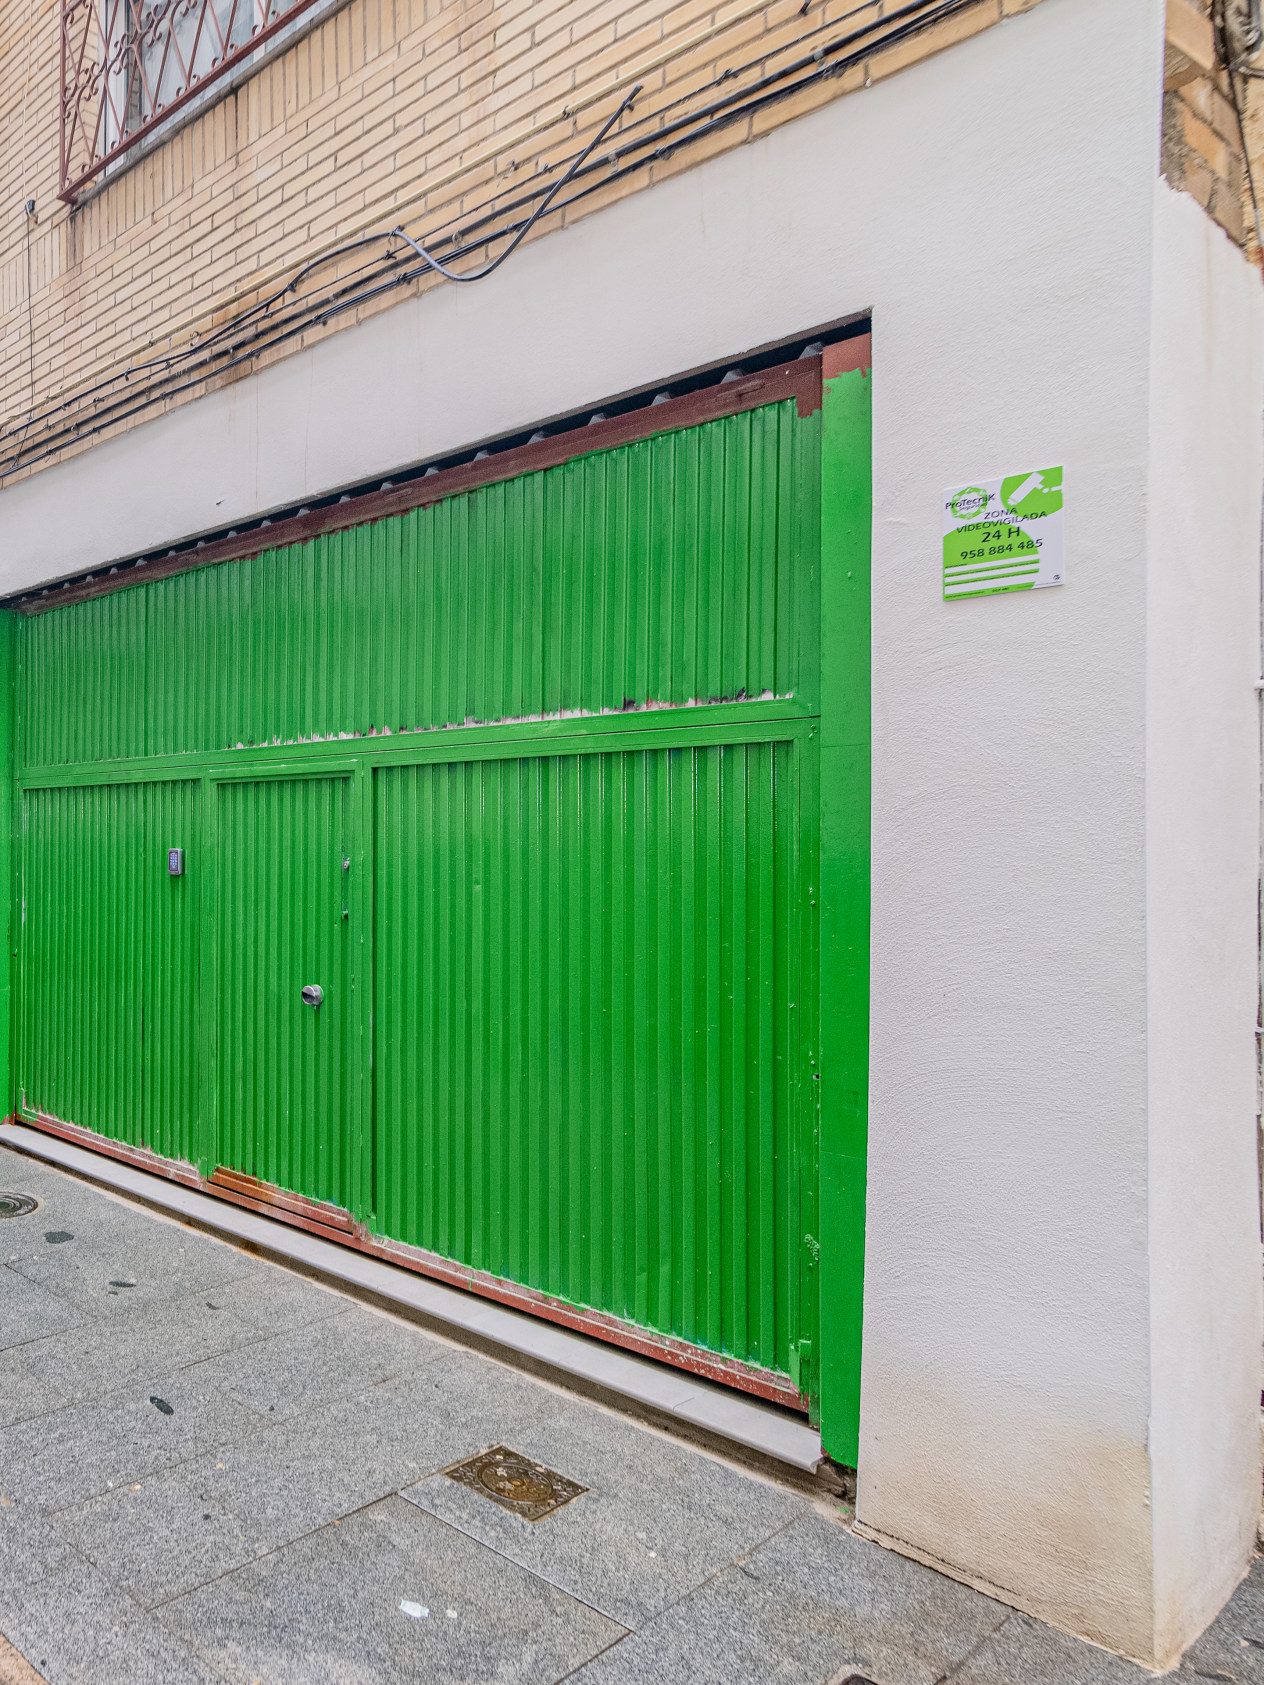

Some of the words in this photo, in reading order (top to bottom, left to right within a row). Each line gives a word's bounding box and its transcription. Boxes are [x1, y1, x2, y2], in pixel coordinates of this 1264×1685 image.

[984, 507, 1018, 520] ZONA
[981, 530, 1002, 543] 24
[1007, 526, 1020, 538] H
[960, 548, 985, 560] 958
[988, 543, 1013, 556] 884
[1017, 538, 1043, 550] 485
